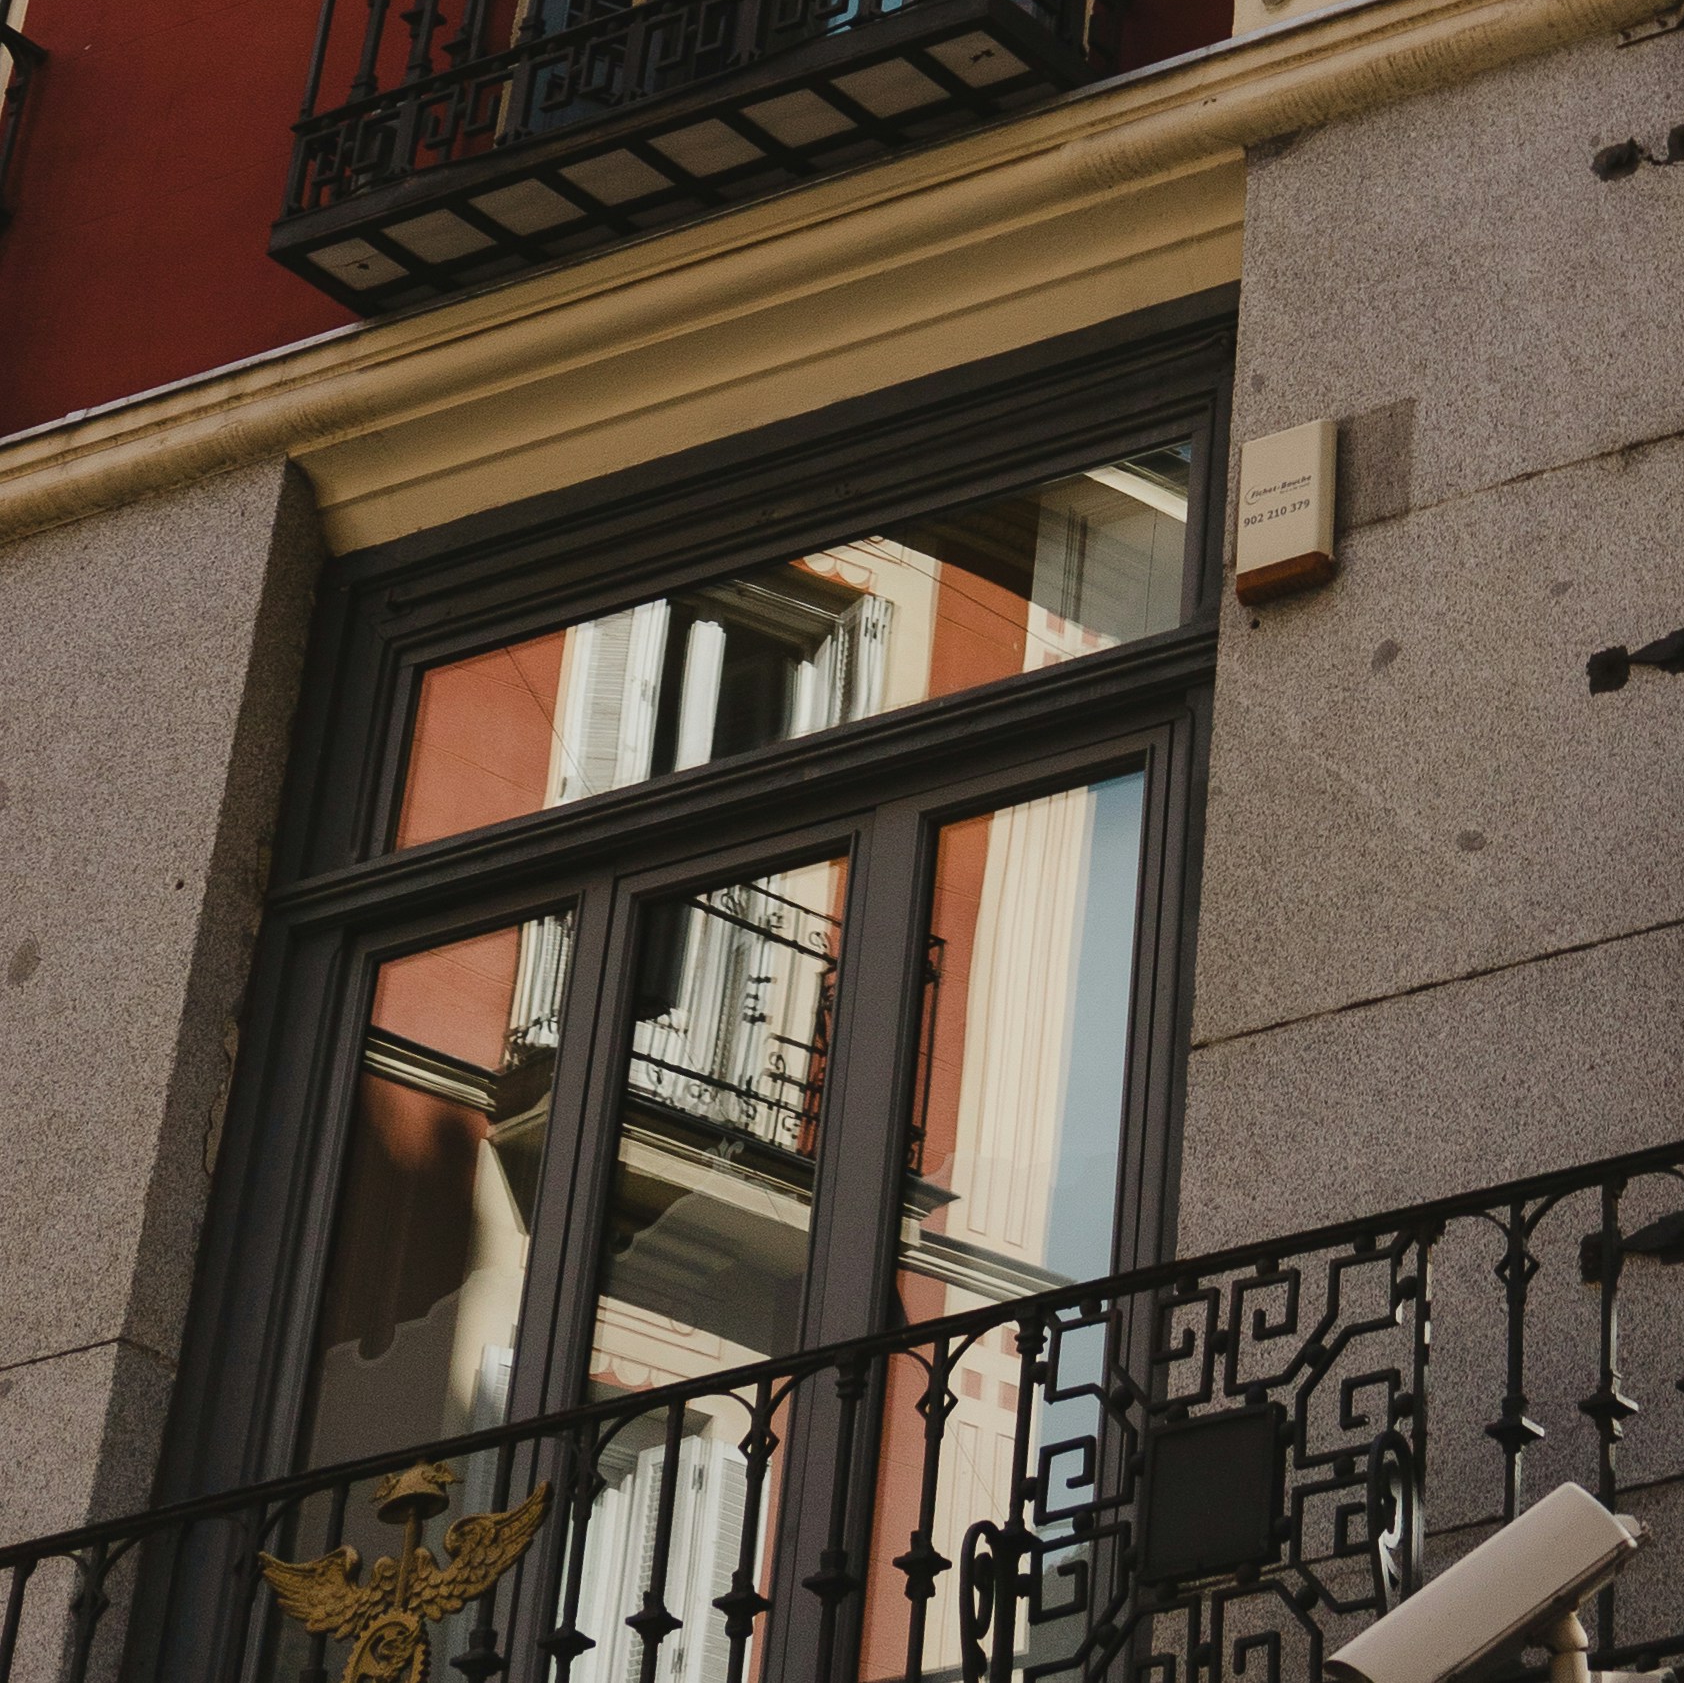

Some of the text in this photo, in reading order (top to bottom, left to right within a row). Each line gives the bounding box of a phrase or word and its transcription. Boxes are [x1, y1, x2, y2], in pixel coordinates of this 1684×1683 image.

[1244, 499, 1310, 528] 902 210 379
